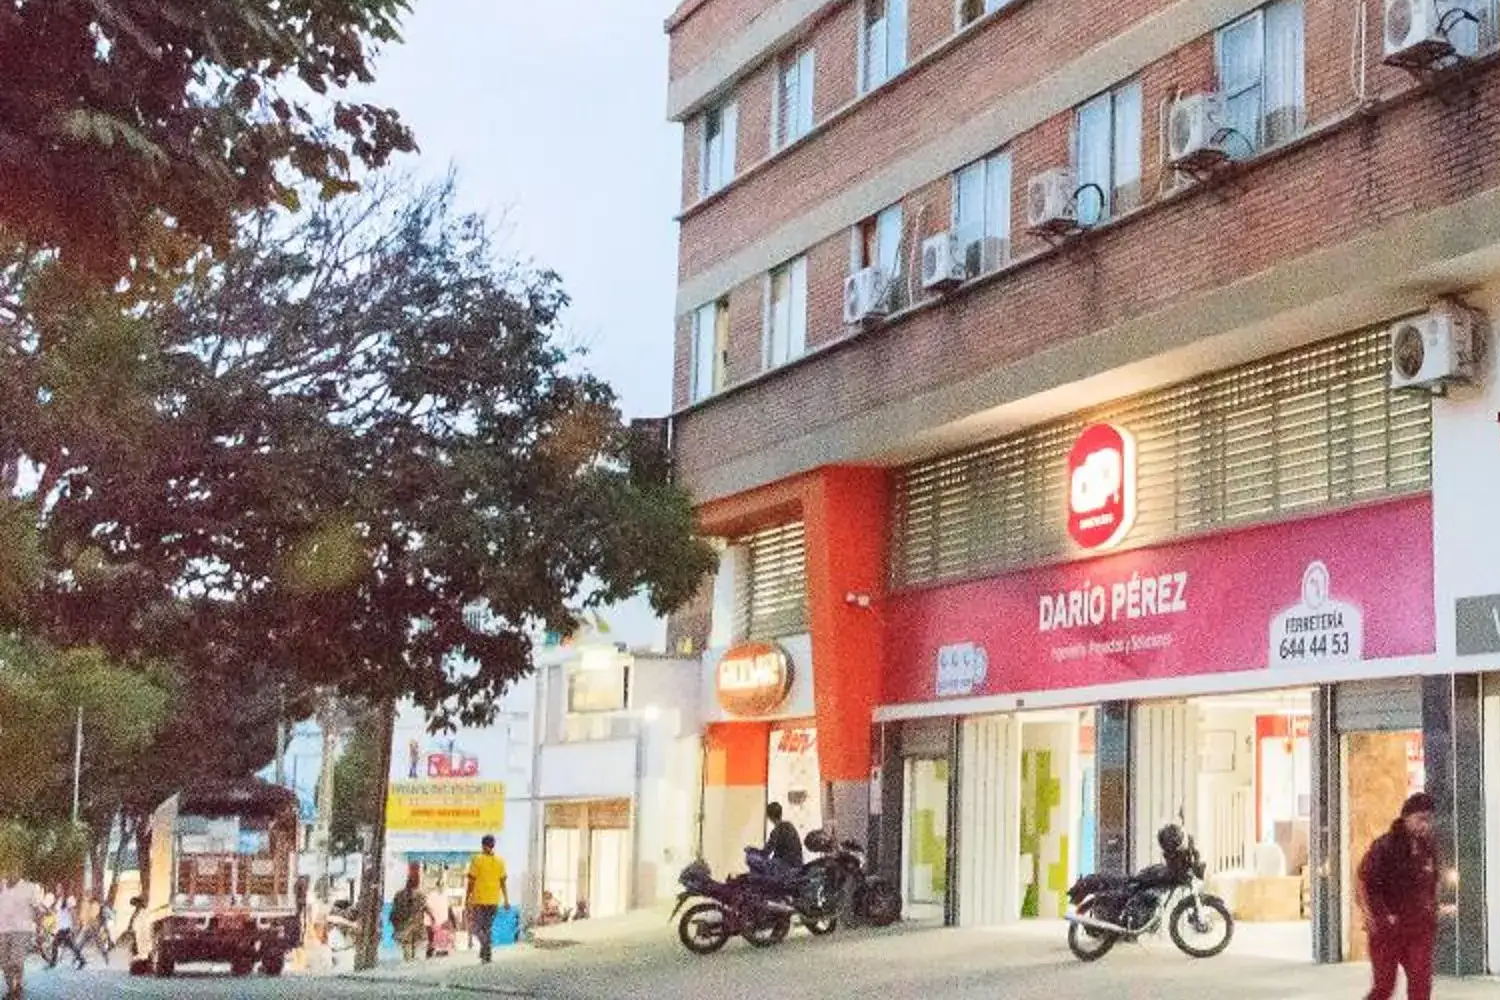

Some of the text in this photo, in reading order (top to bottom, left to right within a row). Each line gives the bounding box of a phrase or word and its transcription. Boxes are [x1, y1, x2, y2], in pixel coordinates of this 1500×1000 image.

[1039, 571, 1188, 631] DARÍO PÉREZ
[1285, 607, 1345, 633] FERRETERÍA
[1279, 631, 1349, 659] 644 44 53
